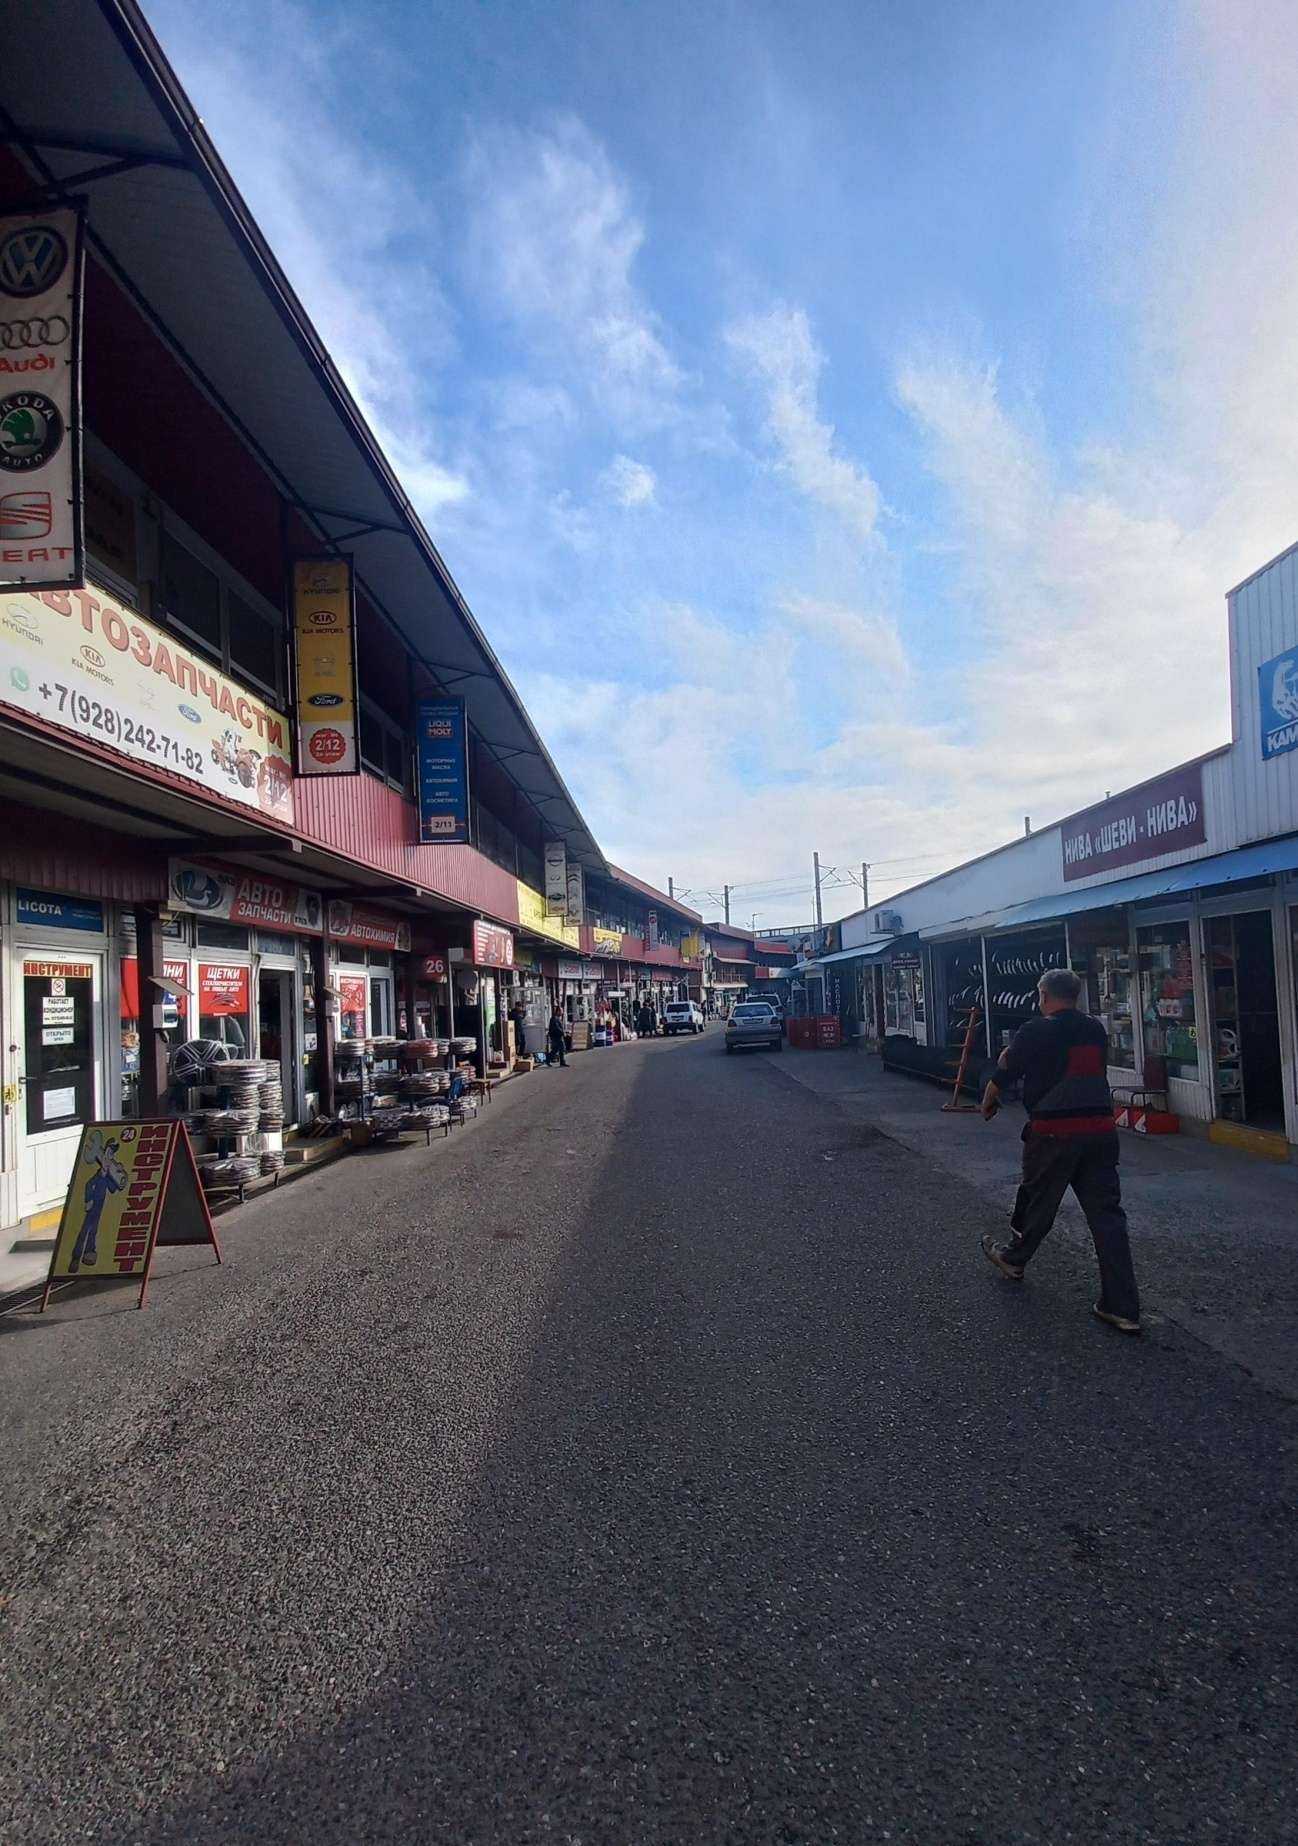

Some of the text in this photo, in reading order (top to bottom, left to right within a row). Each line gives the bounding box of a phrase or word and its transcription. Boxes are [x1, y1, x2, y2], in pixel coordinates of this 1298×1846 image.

[0, 395, 56, 421] KODA
[2, 547, 73, 562] EAT
[2, 617, 44, 646] HYUNDAI
[84, 648, 102, 665] KIA
[28, 591, 283, 749] ВТОЗАПЧАСТИ
[1266, 726, 1298, 753] КАМ
[1065, 832, 1093, 864] НИВА
[1147, 796, 1197, 838] НИВА»
[239, 877, 284, 908] АВТО
[18, 900, 63, 917] LICOTA
[237, 902, 292, 925] ЗАПЧАСТИ
[350, 923, 396, 945] АВТОХИМИЯ
[23, 962, 91, 978] ИНСТРУМЕНТ
[207, 967, 241, 980] ЩЕТКИ
[425, 960, 444, 974] 26
[113, 1126, 169, 1272] ИНСТРУМЕНТ
